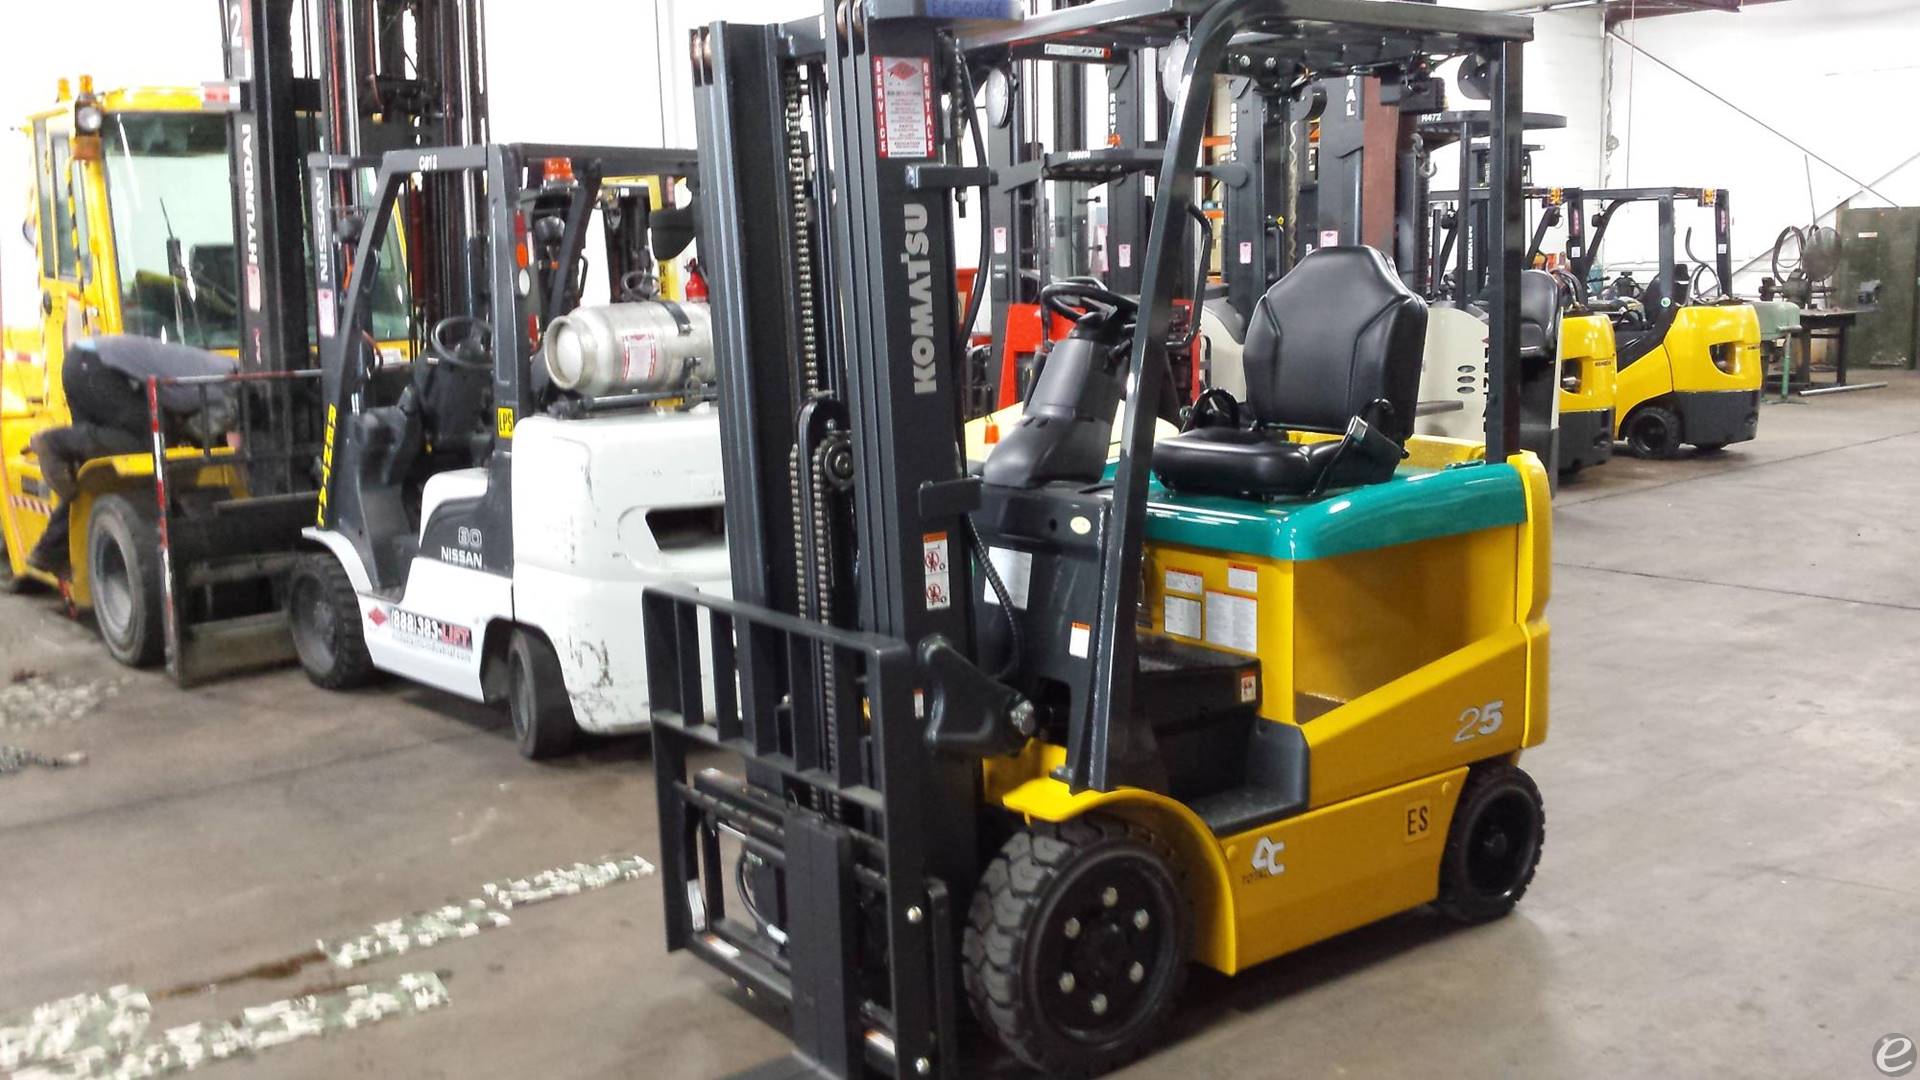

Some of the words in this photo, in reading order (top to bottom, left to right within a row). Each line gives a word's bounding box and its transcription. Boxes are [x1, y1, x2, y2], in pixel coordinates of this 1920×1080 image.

[876, 60, 886, 152] SERVICE
[923, 62, 933, 152] RENTALS
[241, 124, 258, 264] HYUNDAI
[316, 177, 328, 283] NISSAN
[900, 203, 937, 395] KOMATSU
[317, 402, 337, 528] RENTAL
[441, 546, 483, 569] NISSAN
[1453, 700, 1504, 742] 25
[1407, 805, 1429, 836] ES
